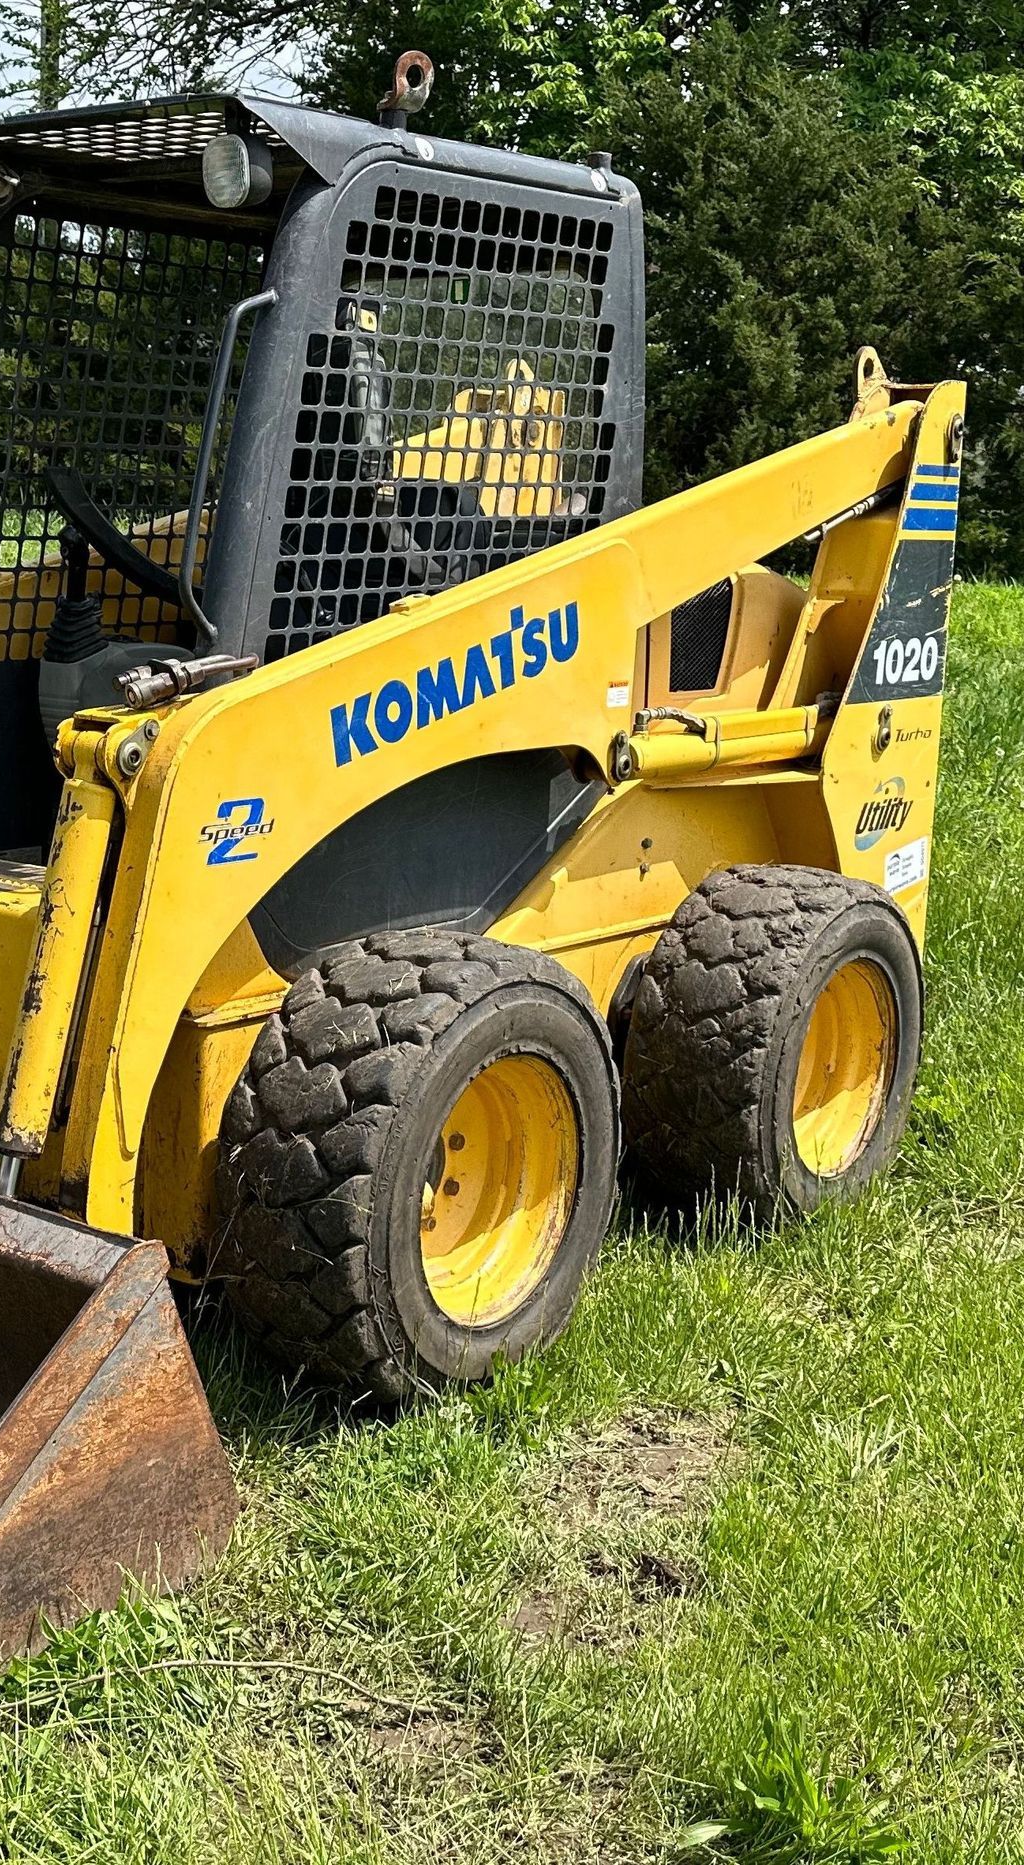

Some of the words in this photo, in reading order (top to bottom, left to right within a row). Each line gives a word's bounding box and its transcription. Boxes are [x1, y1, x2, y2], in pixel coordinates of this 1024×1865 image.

[329, 600, 578, 768] KOMATSU
[873, 636, 938, 686] 1020
[197, 817, 274, 845] Speed
[206, 797, 265, 866] 2
[855, 797, 914, 835] Utility
